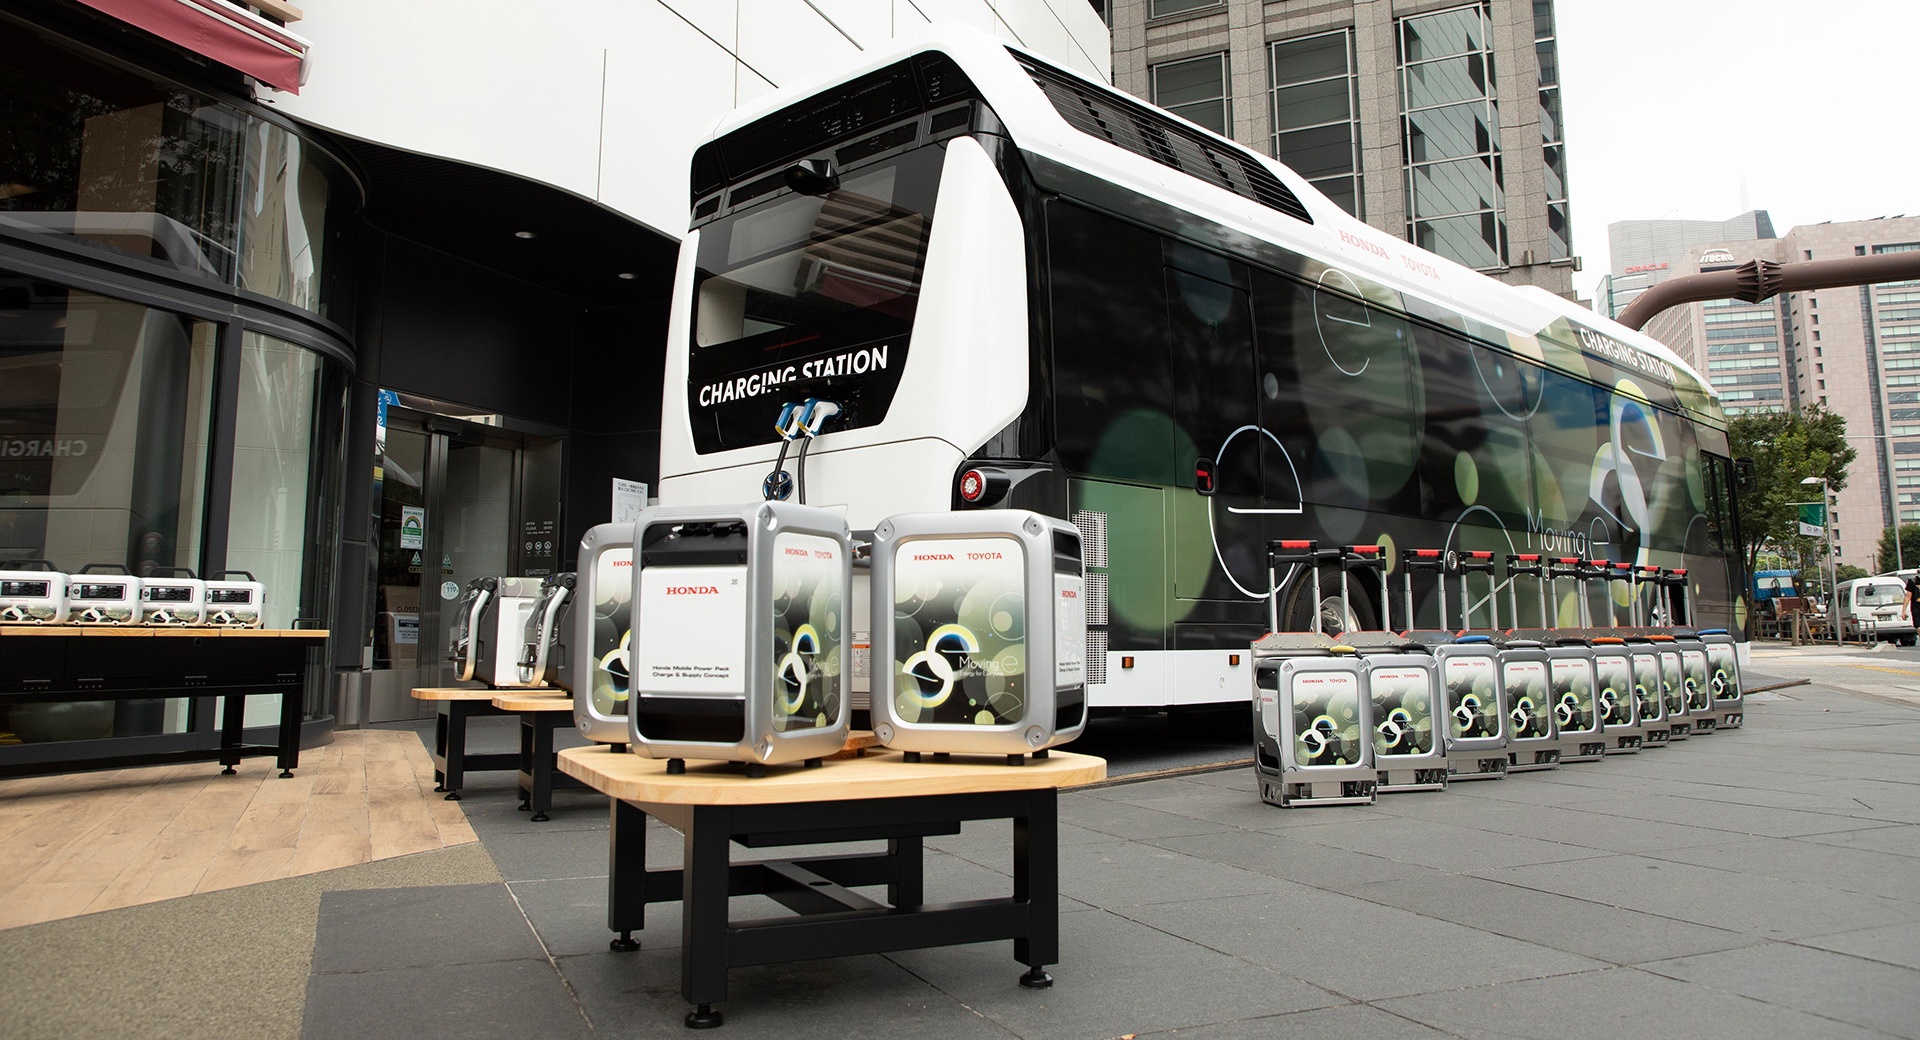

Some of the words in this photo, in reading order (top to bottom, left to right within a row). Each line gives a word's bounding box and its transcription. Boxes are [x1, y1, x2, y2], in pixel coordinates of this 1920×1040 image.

[1339, 229, 1390, 260] HONDA
[1401, 255, 1441, 281] TOYOTA
[1625, 262, 1668, 274] ORACLE
[1580, 327, 1638, 367] CHARGING
[1636, 351, 1677, 383] STATION
[700, 366, 797, 407] CHARGING
[802, 345, 888, 378] STATION
[1526, 506, 1586, 561] Moving
[785, 548, 808, 557] HONDA
[814, 551, 832, 559] TOYOTA
[967, 552, 1003, 560] TOYOTA
[666, 586, 719, 595] HONDA
[959, 656, 999, 671] Moving
[1002, 656, 1018, 674] e
